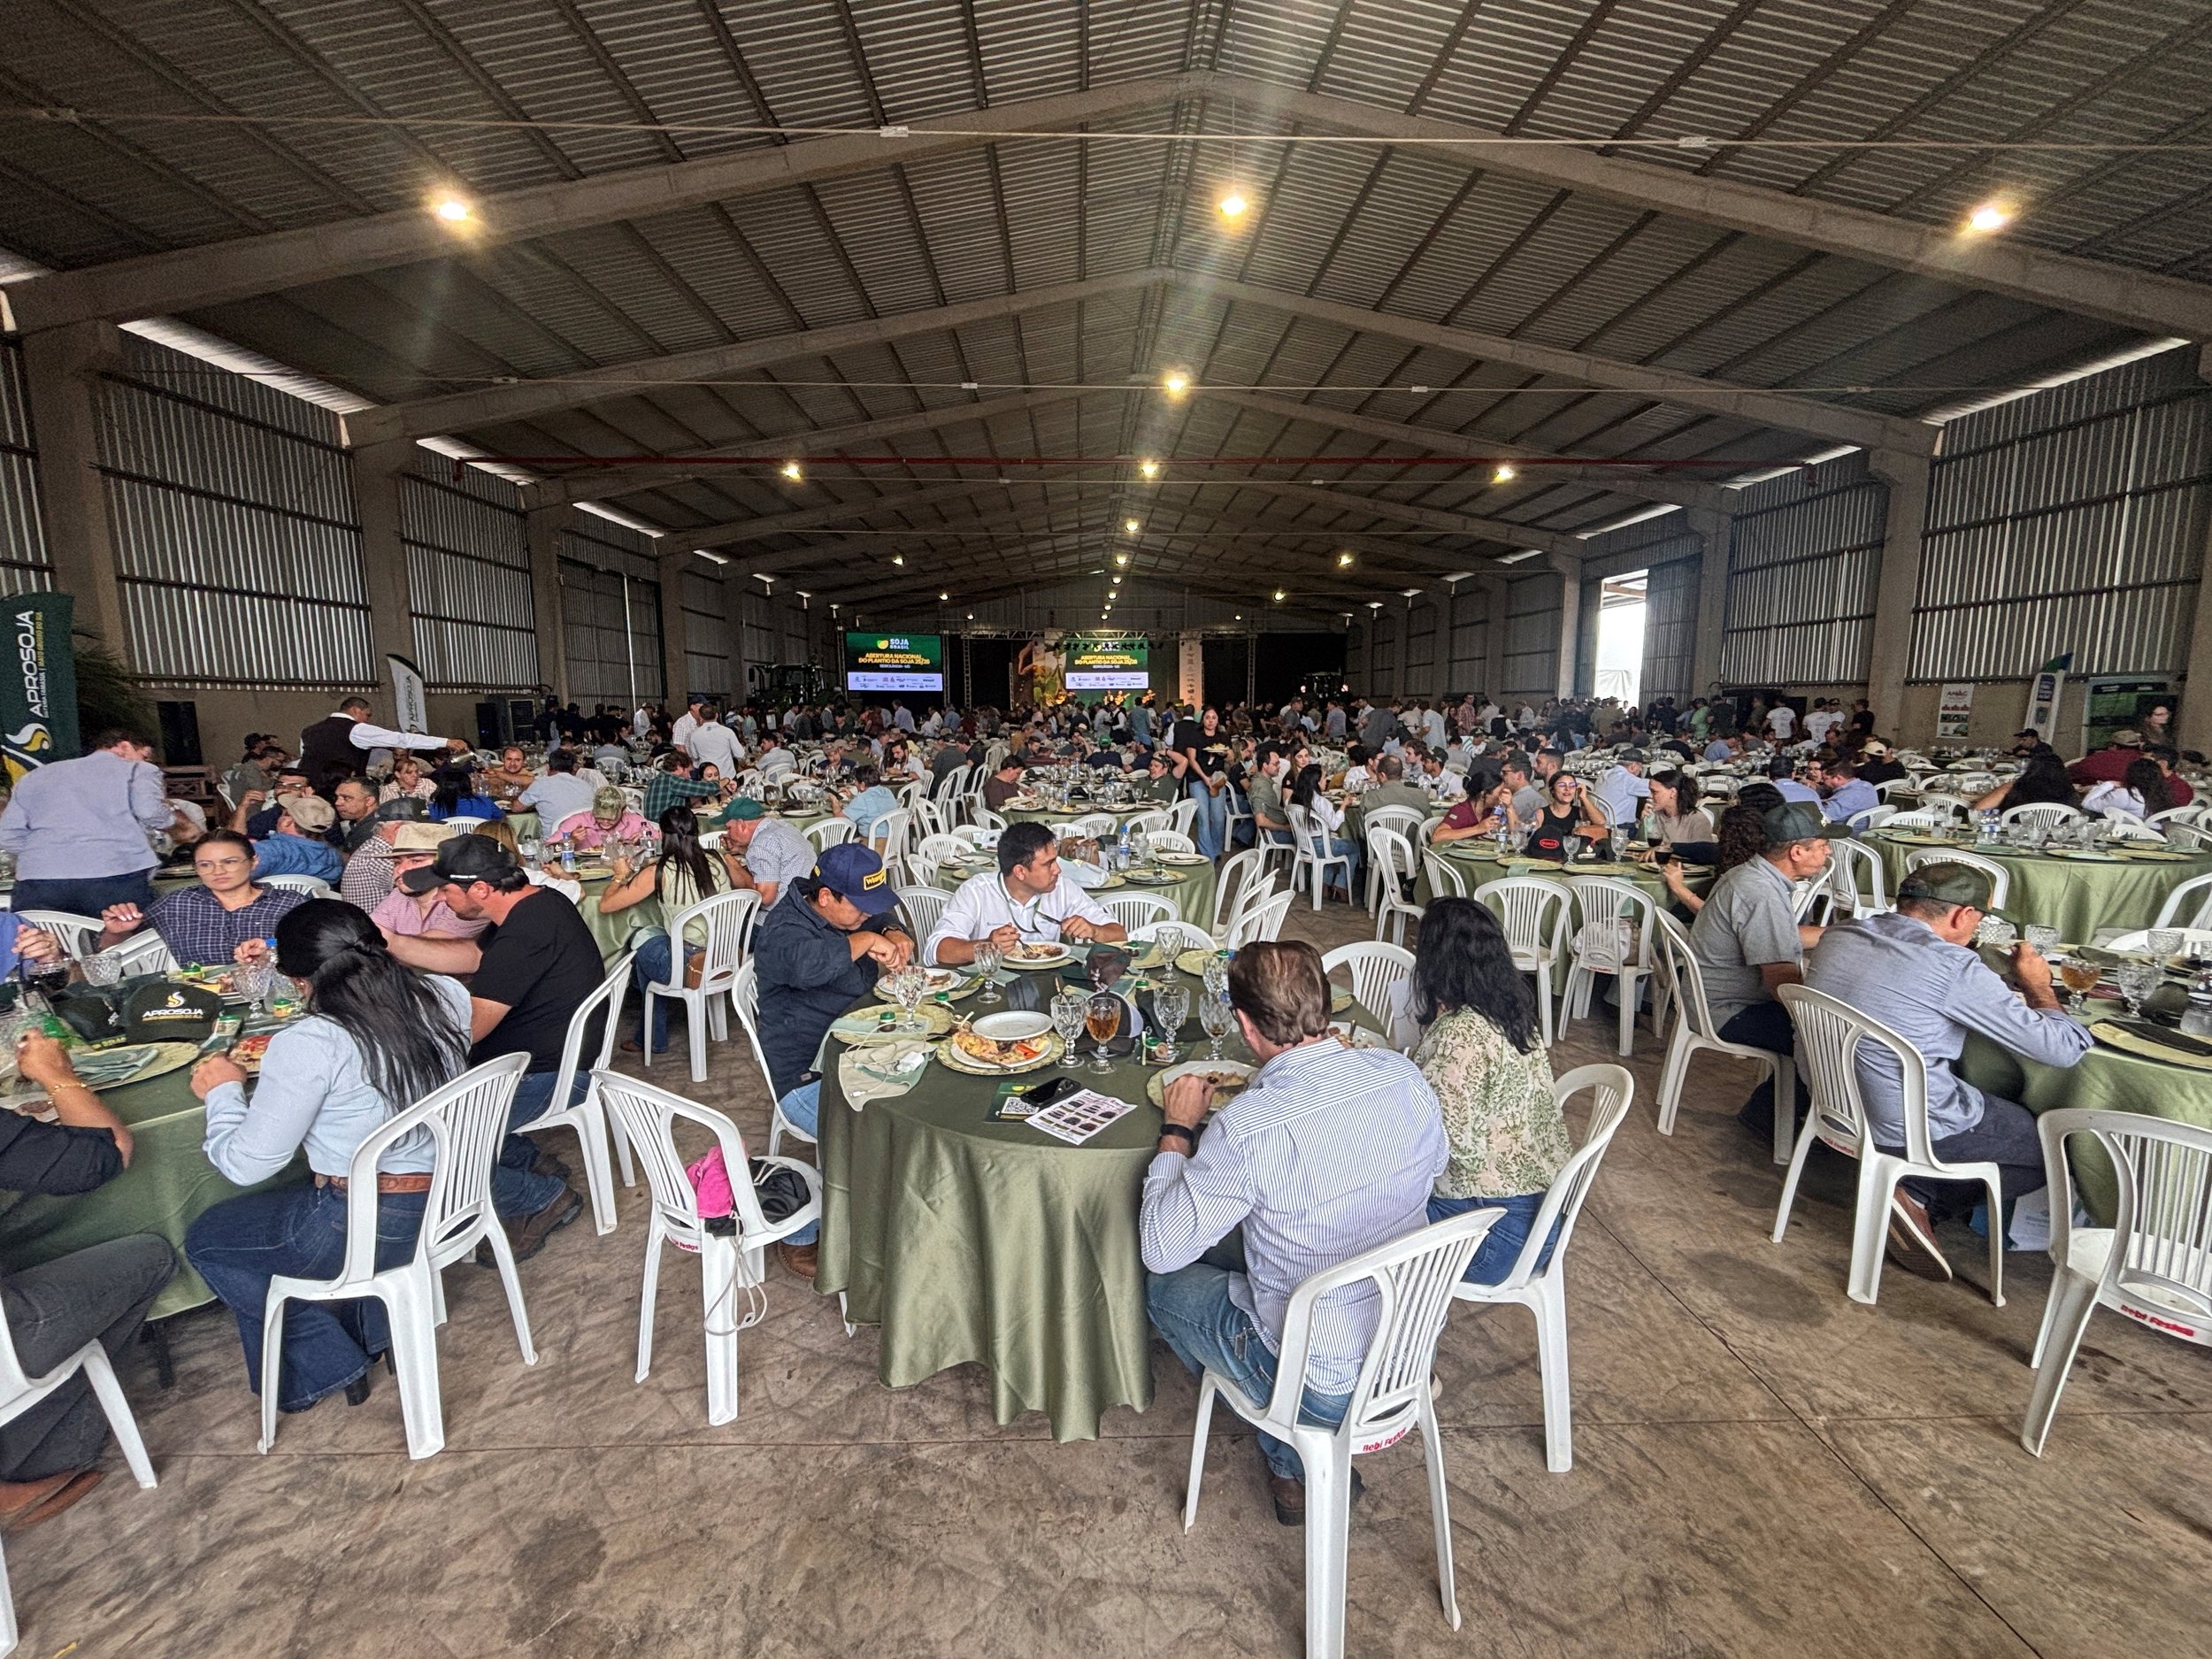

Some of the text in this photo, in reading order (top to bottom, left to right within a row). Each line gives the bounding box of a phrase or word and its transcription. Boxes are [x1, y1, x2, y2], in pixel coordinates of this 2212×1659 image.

[15, 611, 43, 718] APROSOJA
[406, 675, 416, 721] APROSOJA
[142, 1009, 204, 1018] APROSOJA
